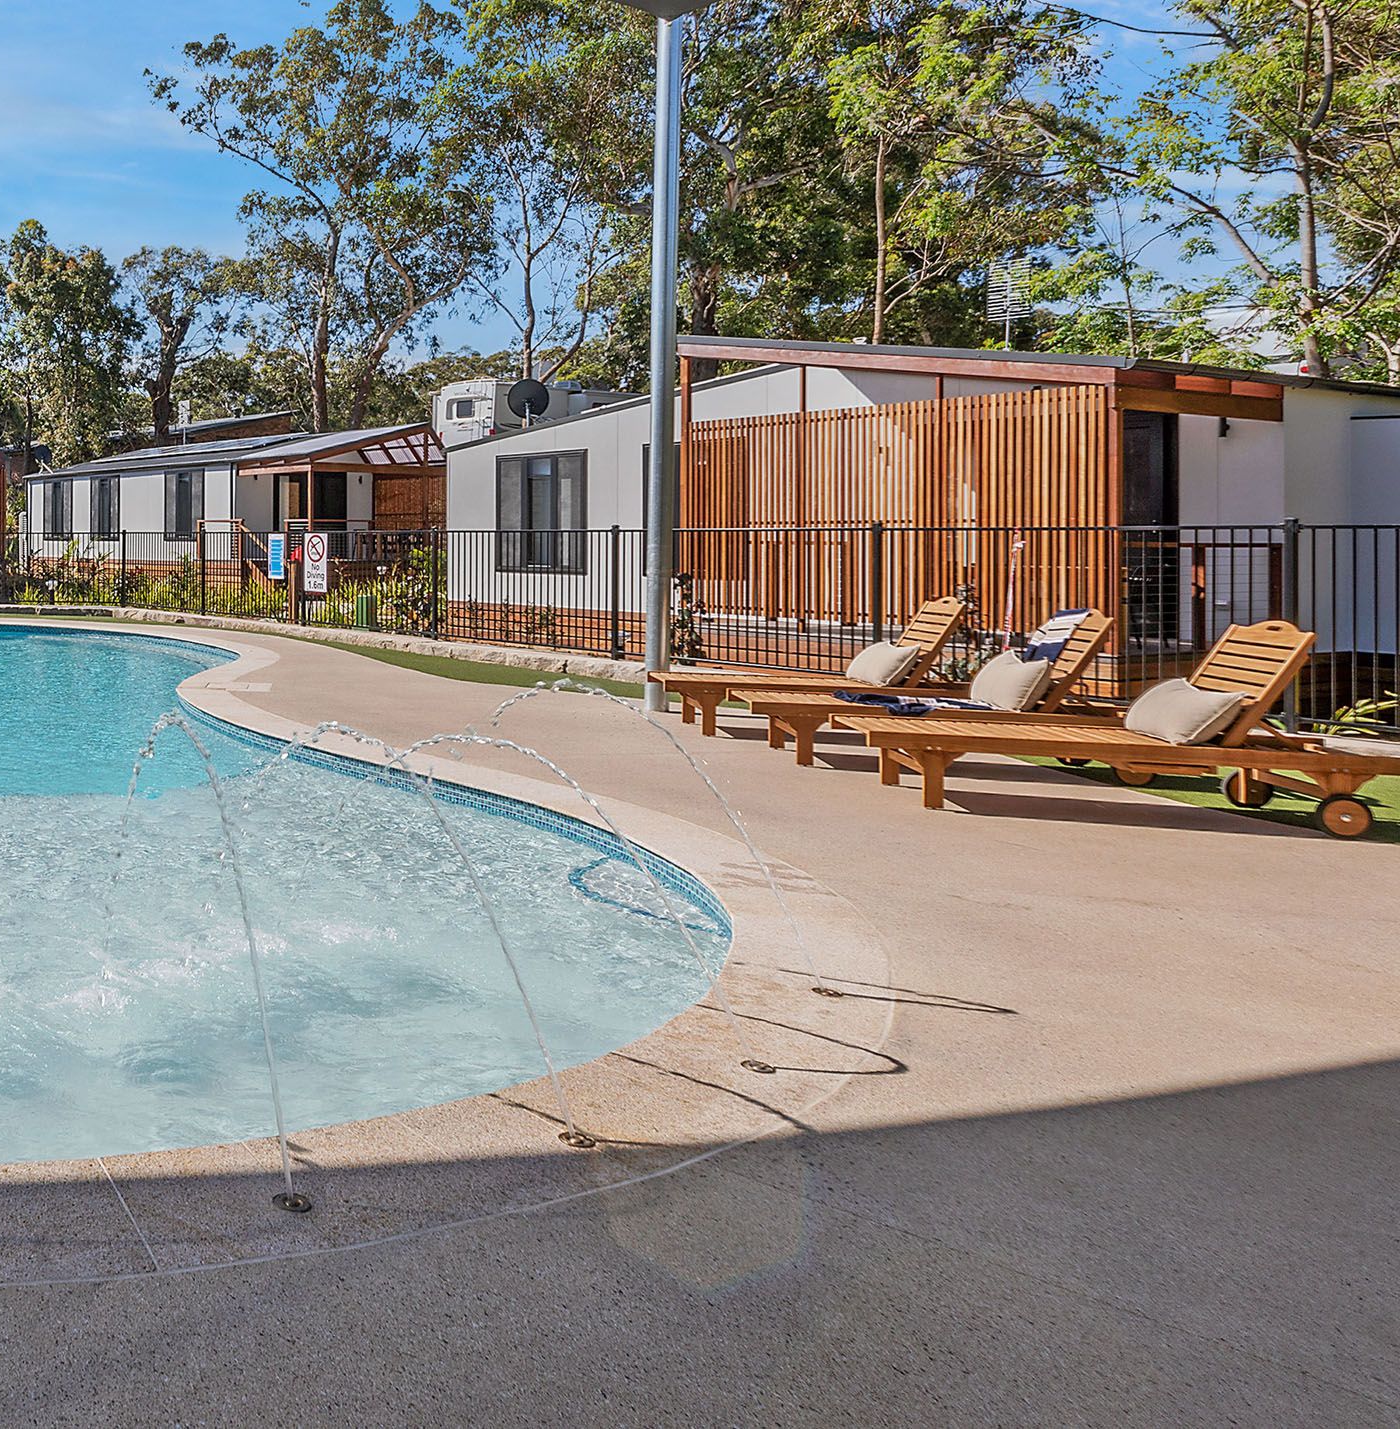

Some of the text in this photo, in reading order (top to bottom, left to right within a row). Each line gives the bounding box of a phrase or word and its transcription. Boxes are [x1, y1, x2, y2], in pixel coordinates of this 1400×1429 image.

[311, 563, 320, 571] No
[306, 570, 325, 581] Diving
[308, 580, 324, 590] 1.6m
